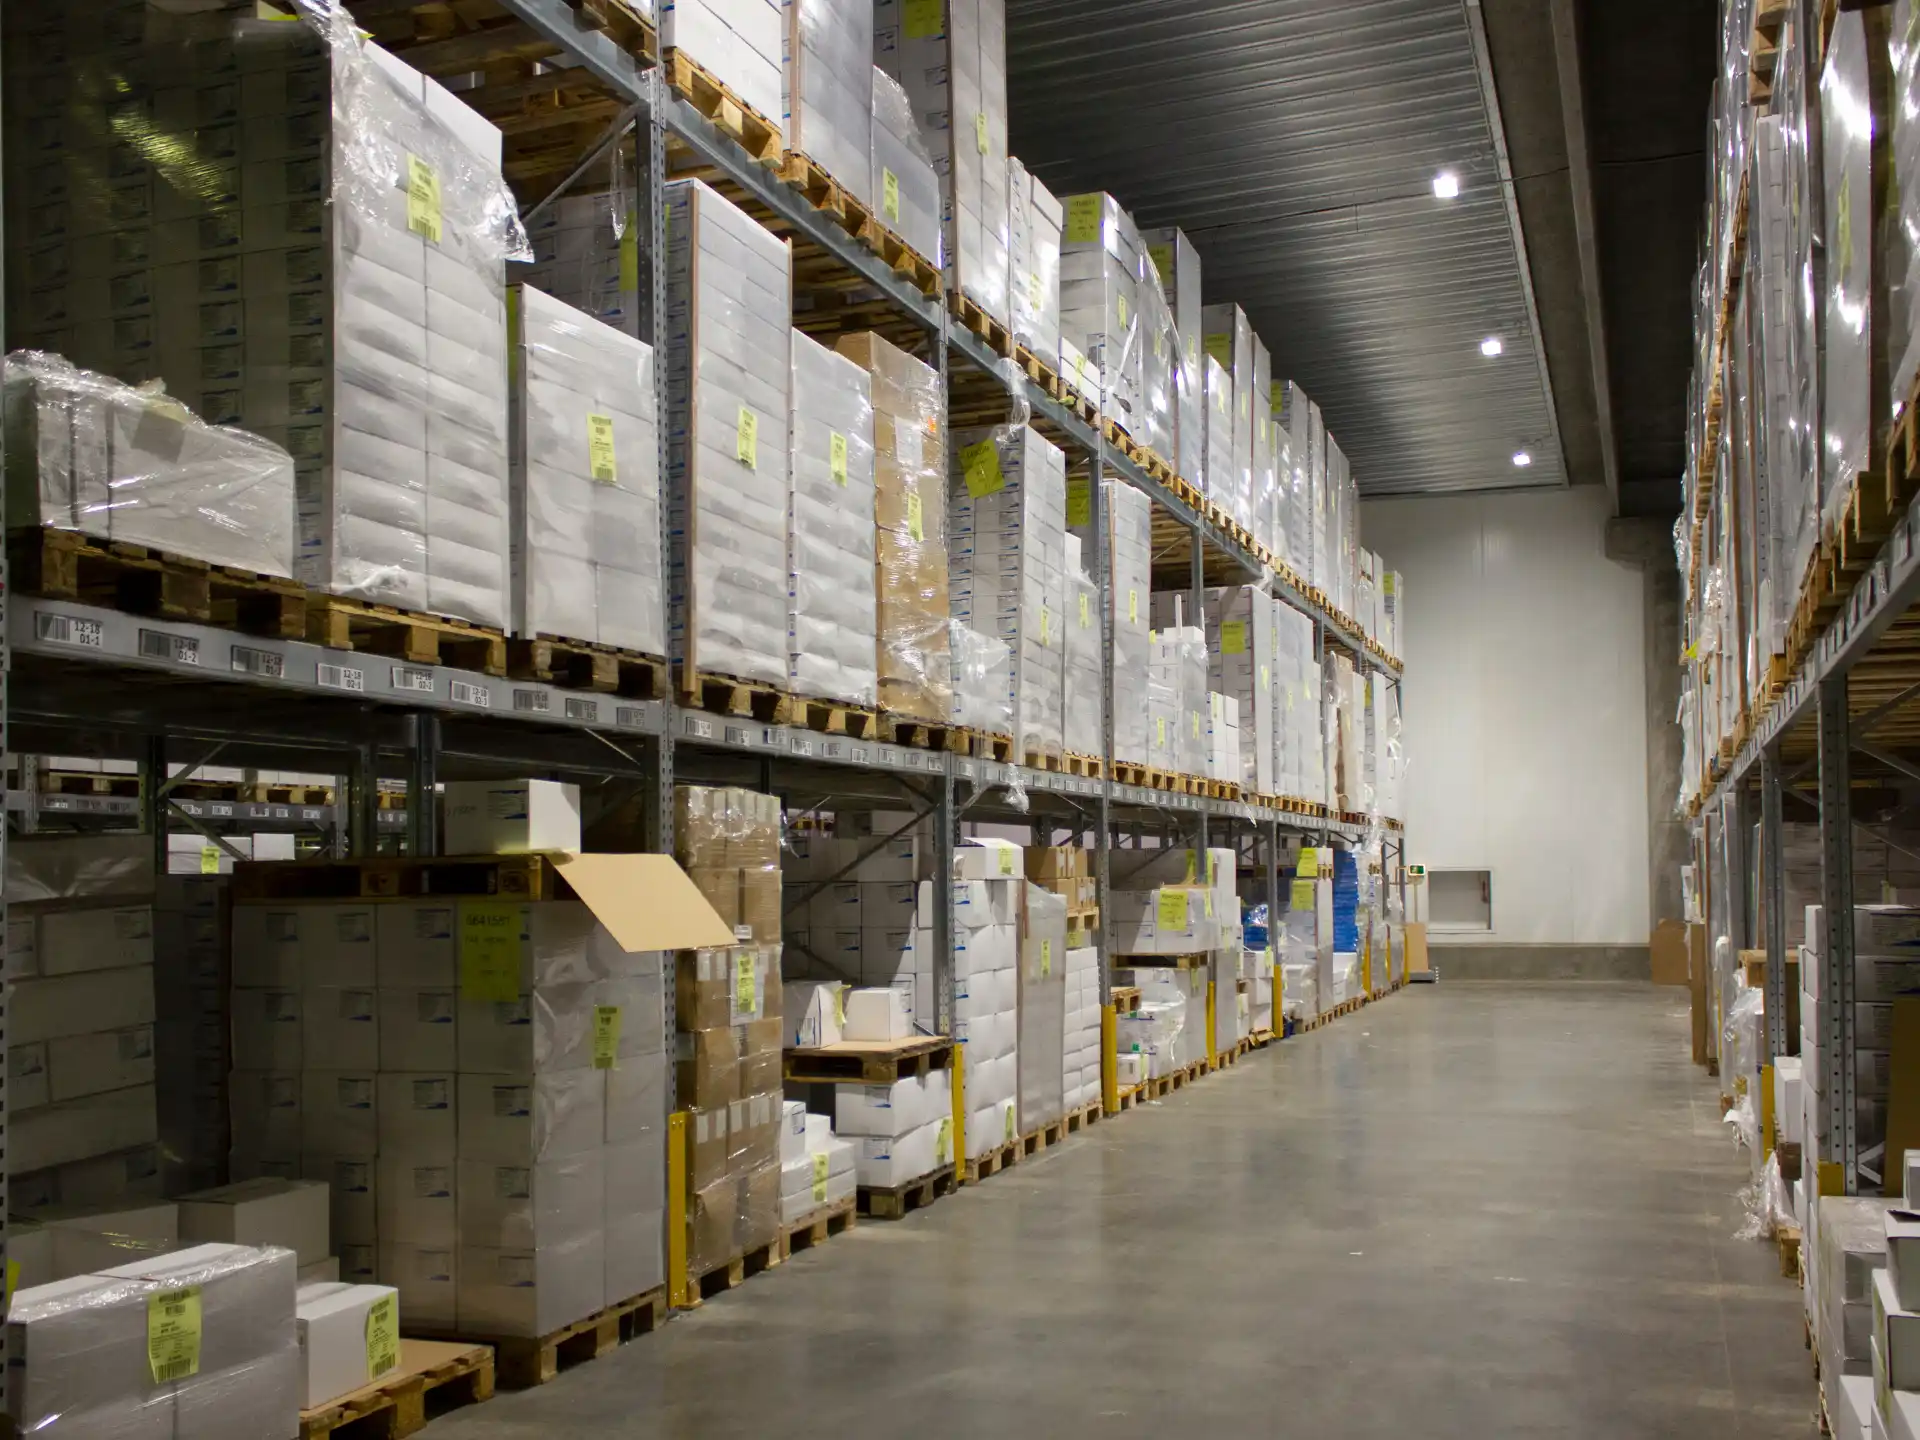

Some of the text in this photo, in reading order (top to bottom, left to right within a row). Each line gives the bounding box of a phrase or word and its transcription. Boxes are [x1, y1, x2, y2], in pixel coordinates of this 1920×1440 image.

[74, 620, 100, 635] 12-18
[80, 633, 100, 646] 01-1
[179, 650, 197, 663] 01-2
